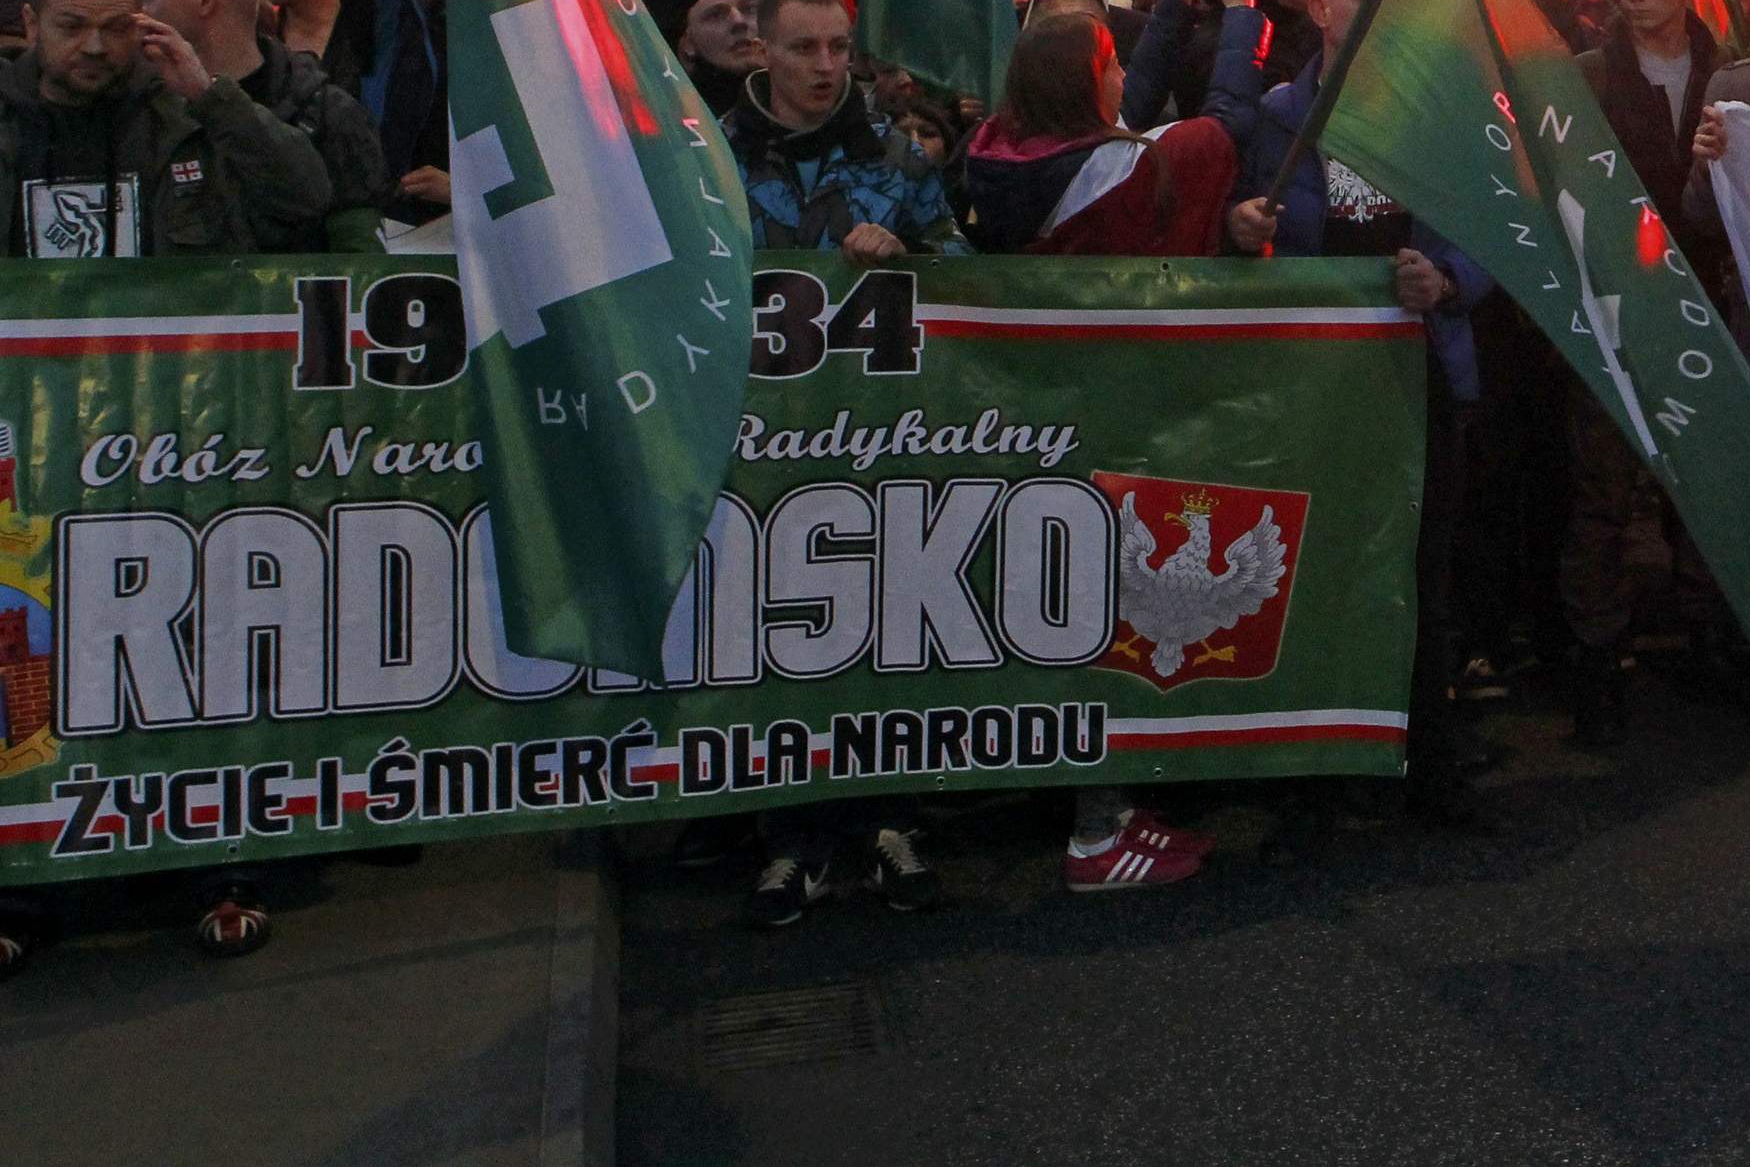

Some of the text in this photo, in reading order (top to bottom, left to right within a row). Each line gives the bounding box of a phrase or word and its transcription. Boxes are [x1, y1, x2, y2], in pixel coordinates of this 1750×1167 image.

[79, 408, 1080, 487] Obóz Naro Radykalny
[50, 701, 1108, 859] ŻYCIE I ŚMIERĆ DLA NARODU
